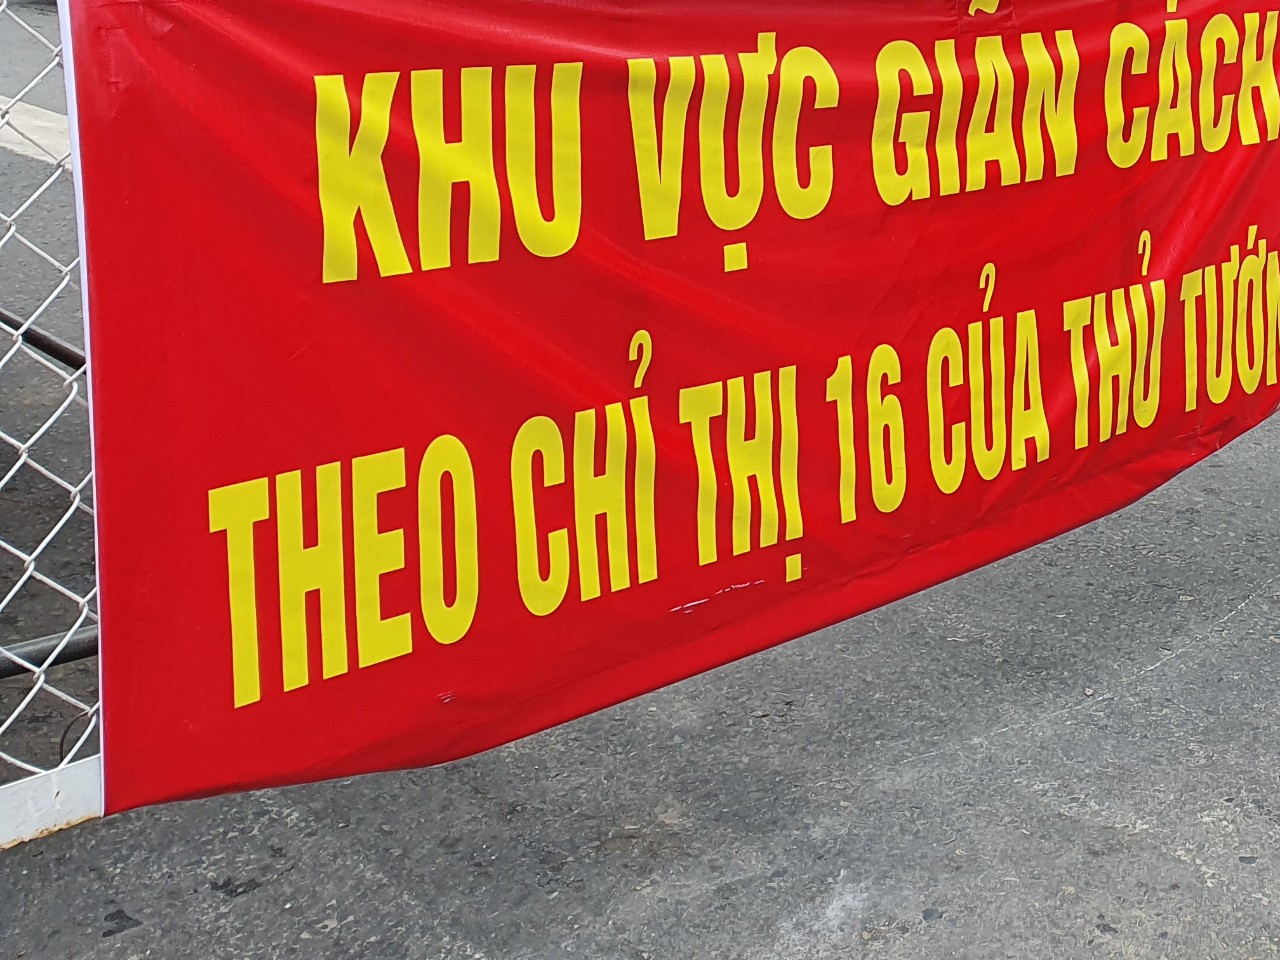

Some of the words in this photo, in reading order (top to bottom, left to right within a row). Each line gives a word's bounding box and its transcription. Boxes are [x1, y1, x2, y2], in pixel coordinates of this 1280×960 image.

[314, 61, 583, 283] KHU
[627, 31, 839, 272] VỰC
[208, 435, 478, 708] THEO
[511, 329, 657, 617] CHỈ
[679, 365, 803, 582] THỊ
[826, 344, 906, 523] 16
[927, 262, 1050, 495] CỦA
[1063, 230, 1166, 450] THỦ
